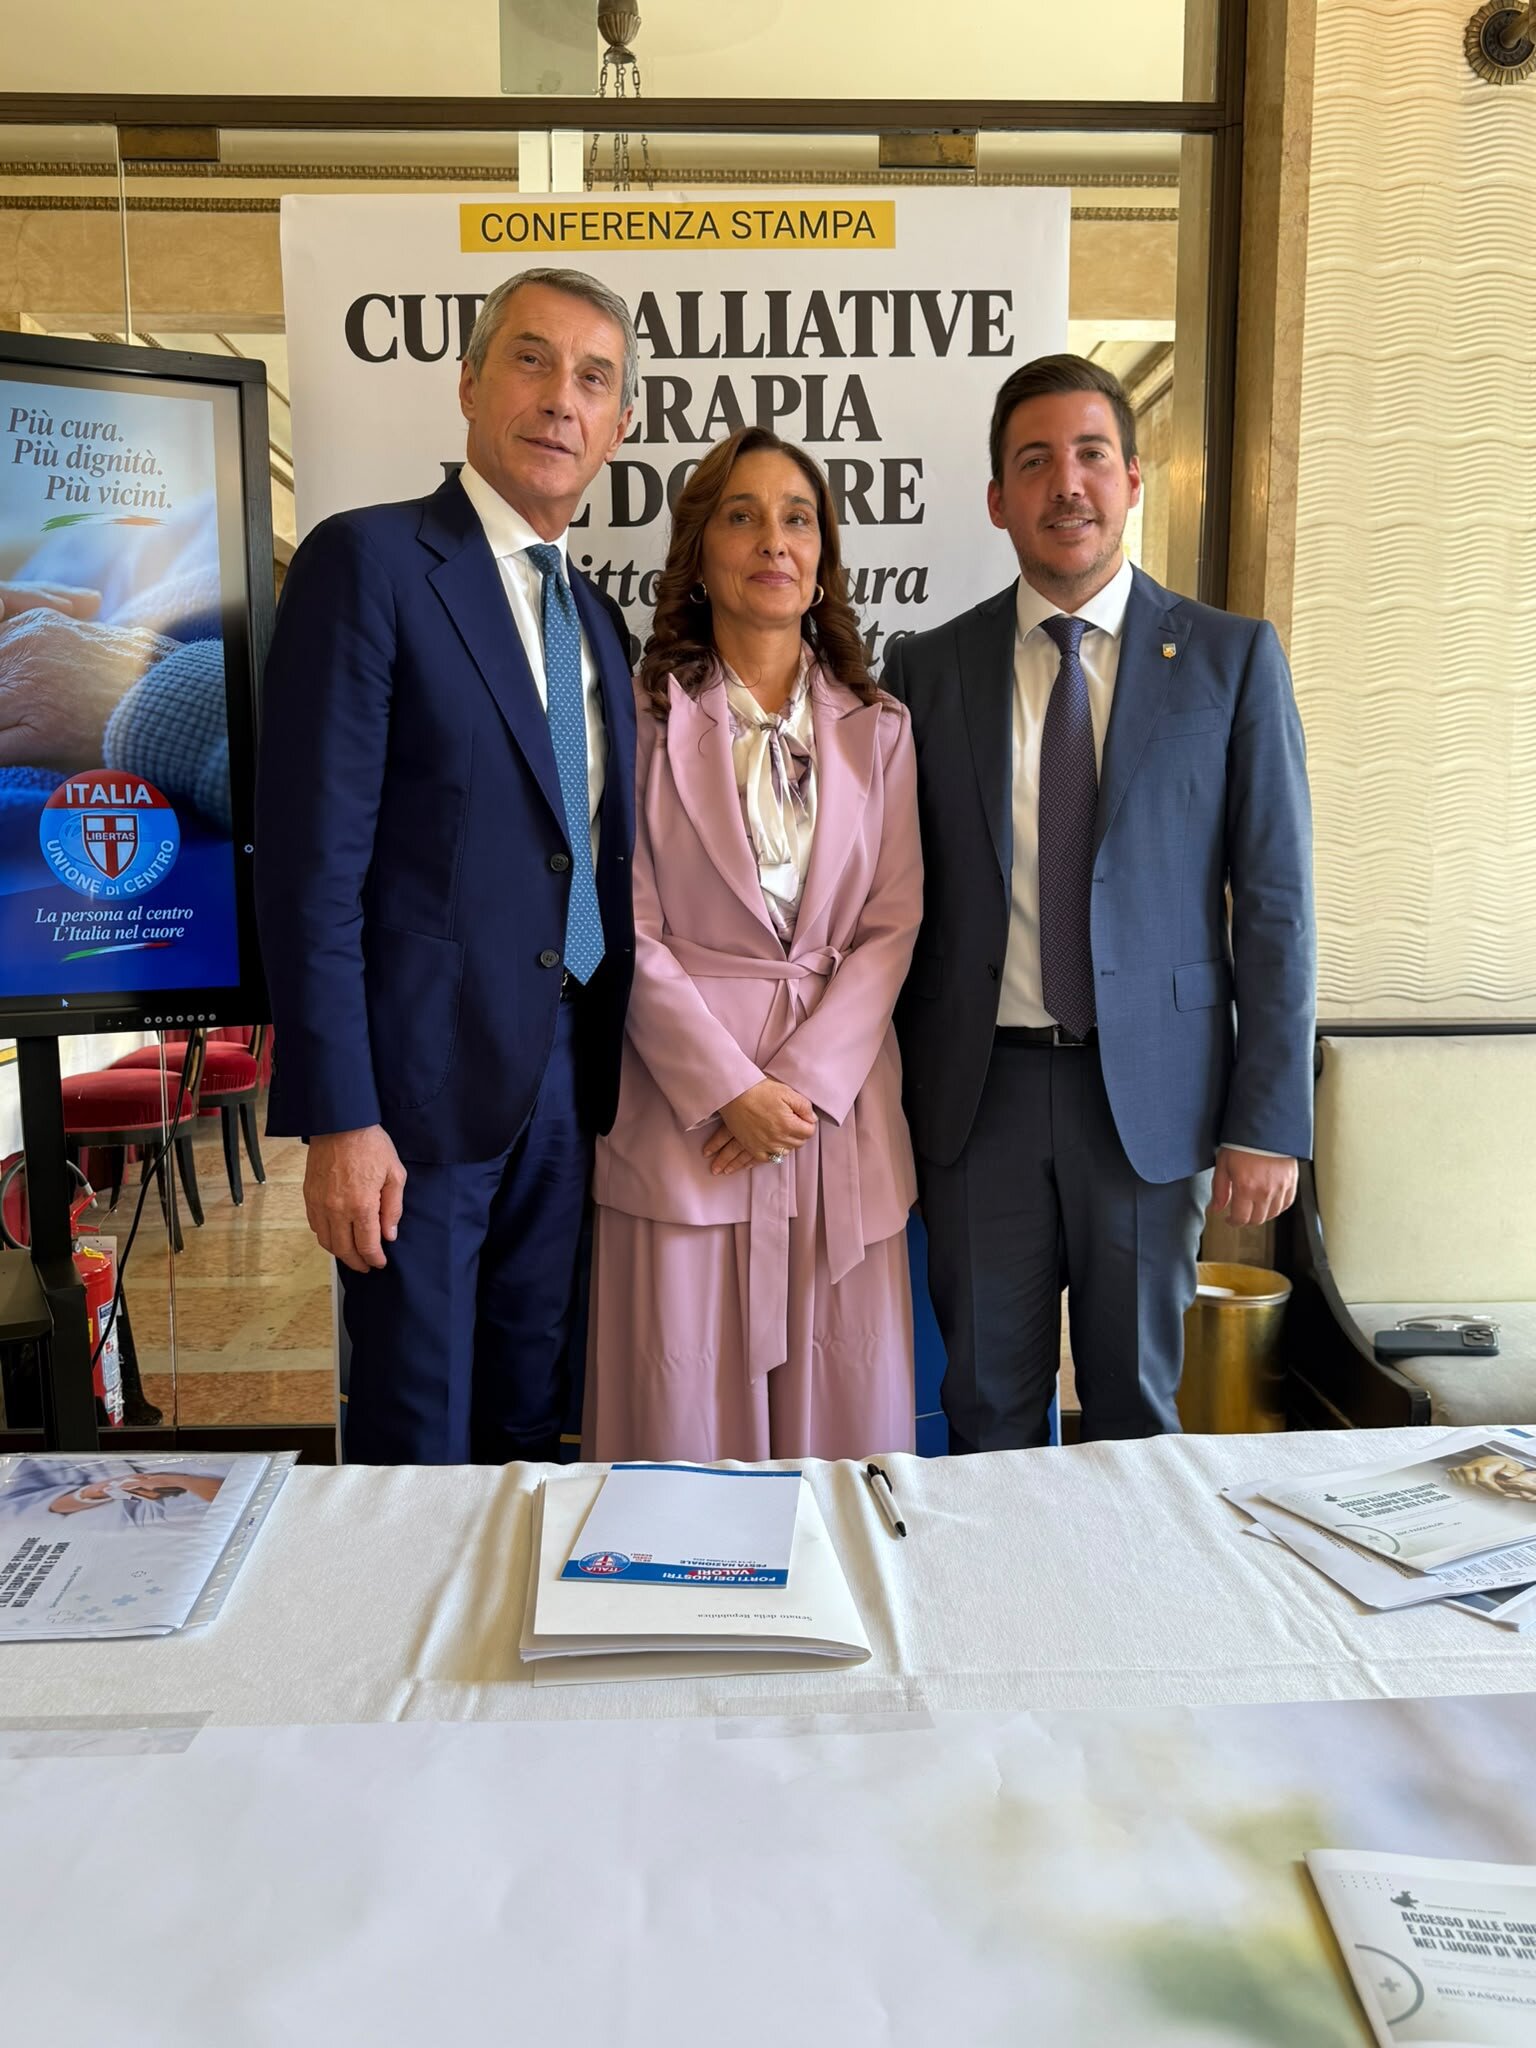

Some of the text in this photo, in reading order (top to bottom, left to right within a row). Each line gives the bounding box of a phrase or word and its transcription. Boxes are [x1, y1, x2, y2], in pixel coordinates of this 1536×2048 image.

[481, 207, 876, 244] CONFERENZA STAMPA
[344, 289, 1015, 363] CU ALLIATIVE
[624, 374, 882, 444] RAPIA
[7, 407, 125, 442] Più cura.
[11, 438, 164, 478] Più dignità.
[44, 474, 173, 509] Più vicini.
[842, 566, 929, 605] ura
[65, 783, 153, 804] ITALIA
[86, 832, 136, 842] LIBERTAS
[46, 839, 175, 896] UNIONE DI CENTRO
[35, 906, 194, 926] La persona al centro
[115, 924, 139, 939] nel
[142, 926, 185, 939] cuore
[662, 1572, 711, 1581] NOSTRI
[1401, 1911, 1464, 1928] ACCESSO
[1467, 1918, 1502, 1932] ALLE
[1406, 1924, 1536, 1947] E ALLA TERAPIA DE
[1413, 1937, 1536, 1960] NEI LUOGHI DI VIT
